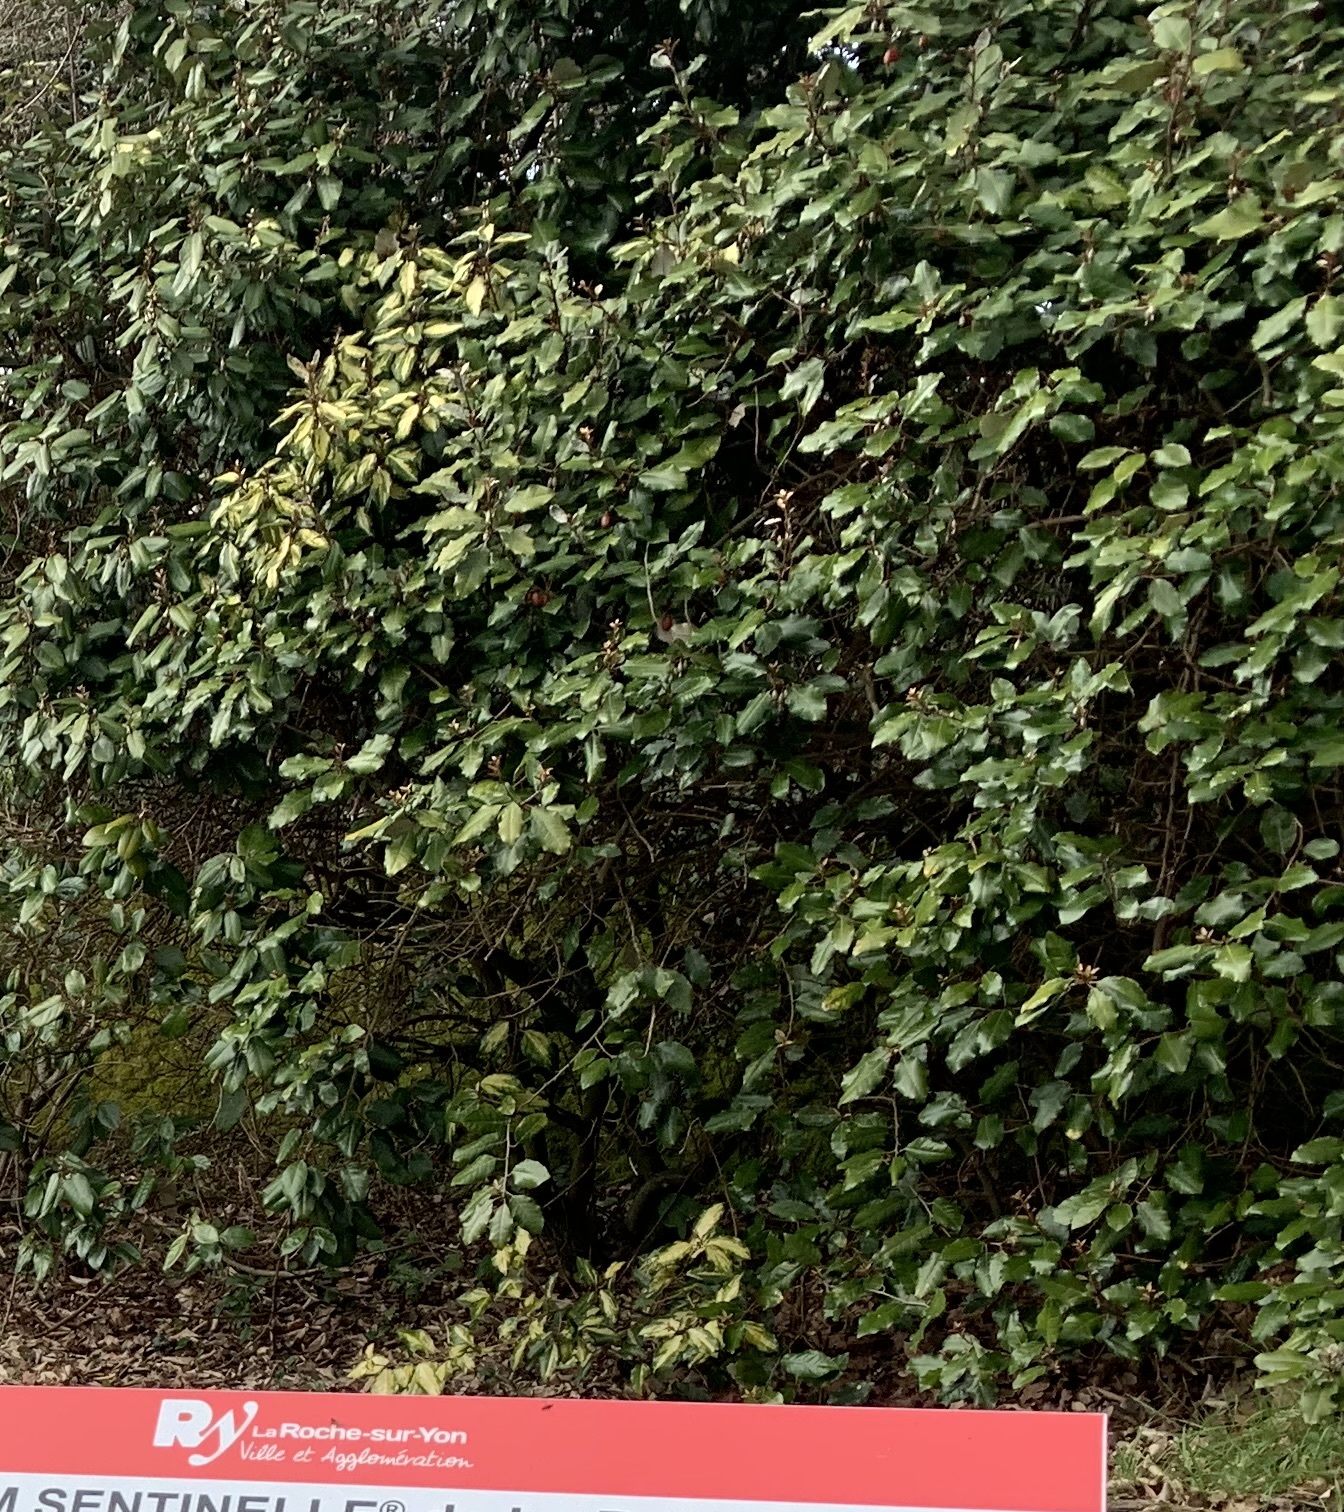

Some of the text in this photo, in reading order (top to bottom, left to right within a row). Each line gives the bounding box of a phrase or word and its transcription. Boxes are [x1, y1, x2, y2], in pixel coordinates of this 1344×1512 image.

[252, 1423, 468, 1445] La Roche-sur-Yon
[240, 1439, 474, 1472] Ville et Agglomération
